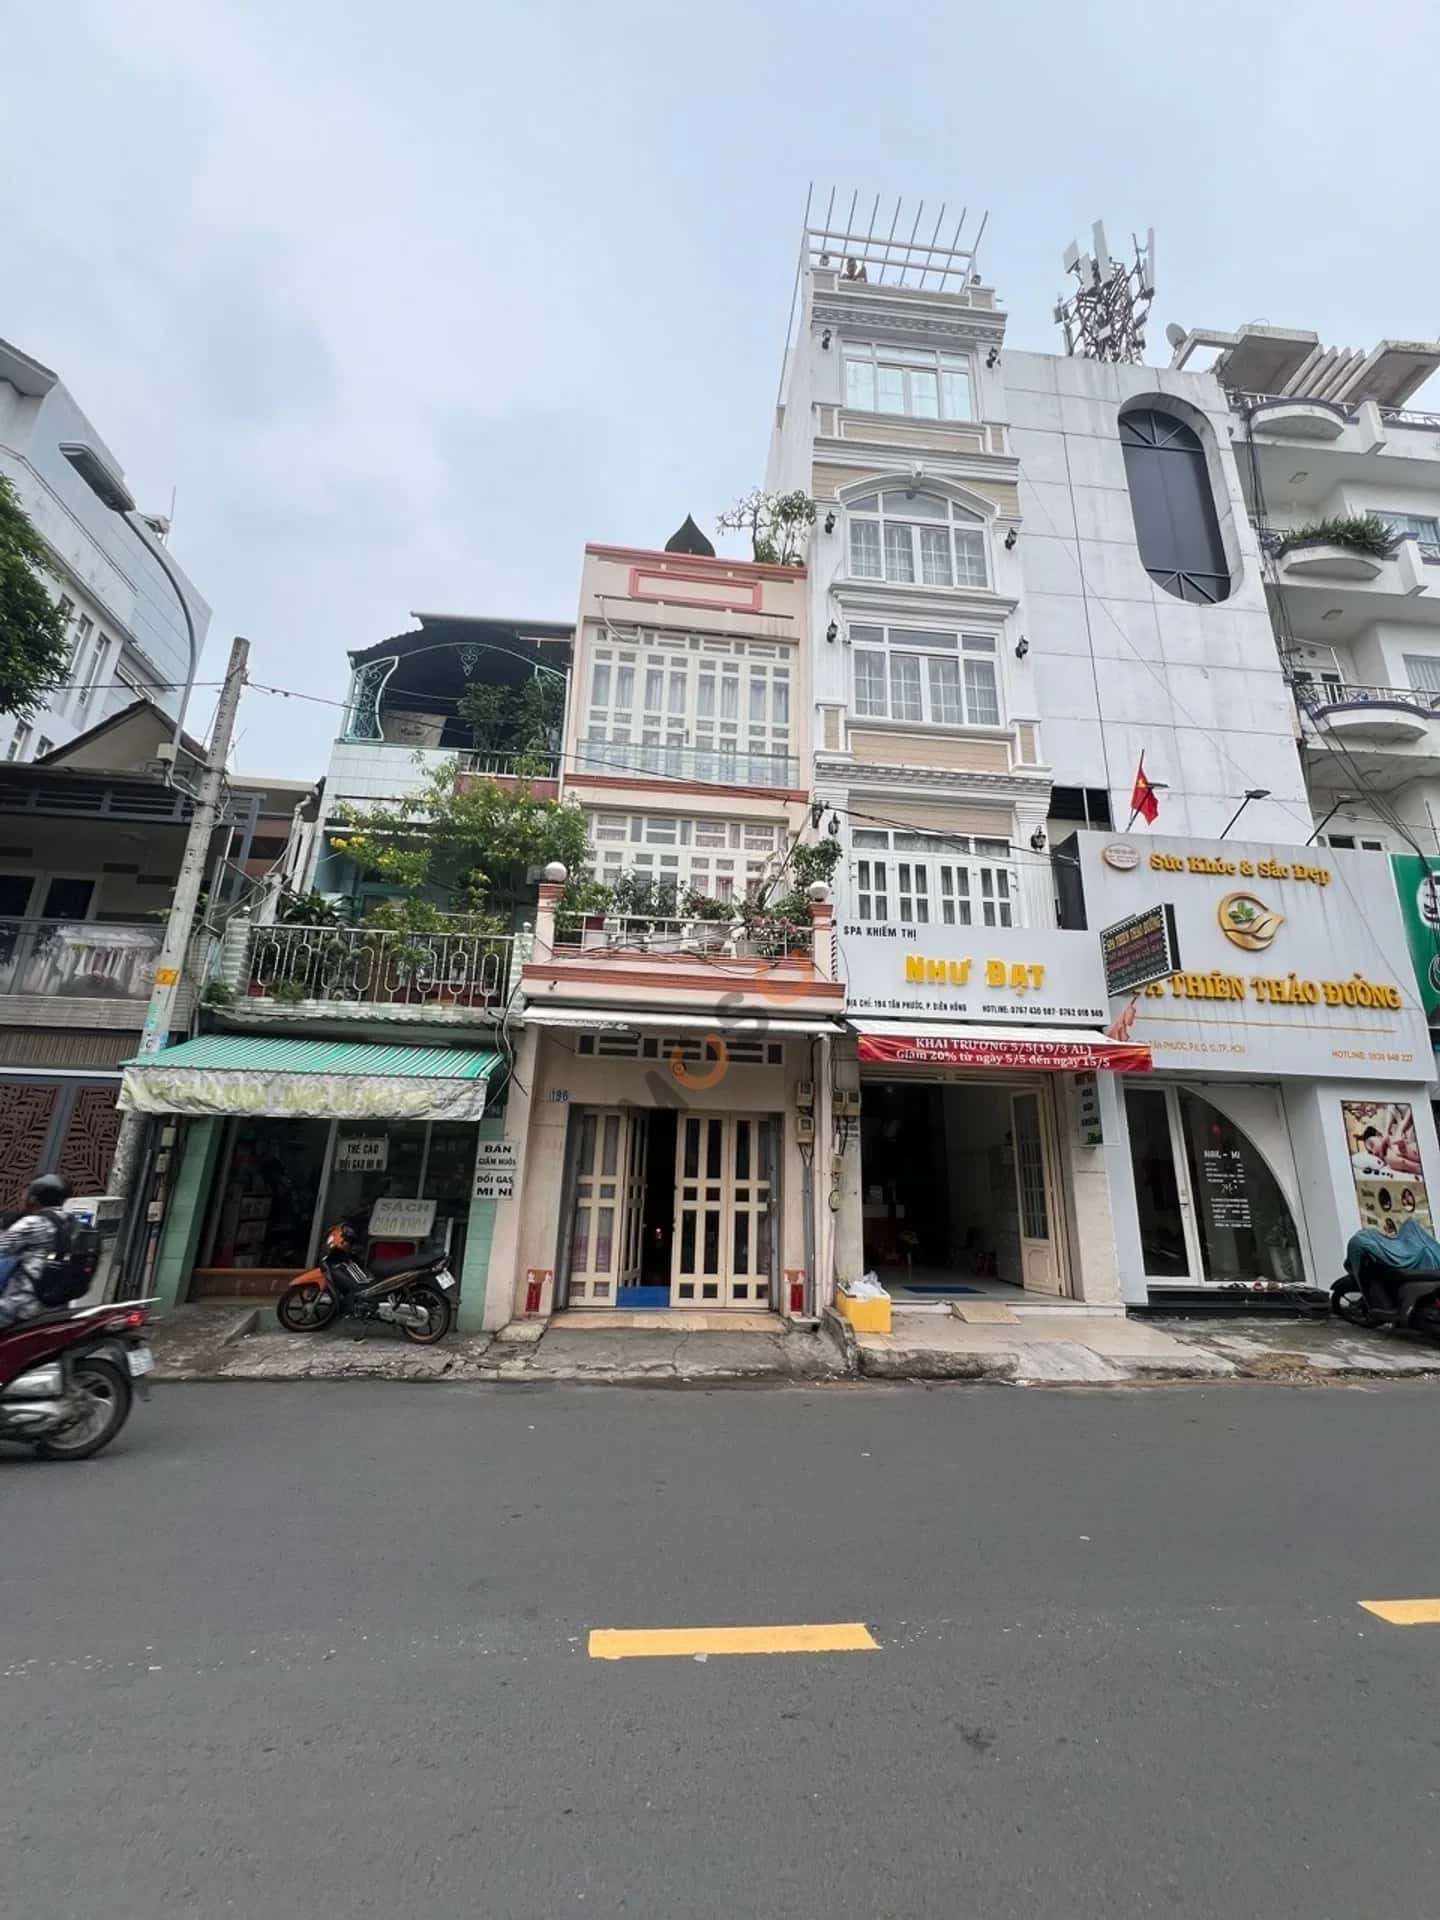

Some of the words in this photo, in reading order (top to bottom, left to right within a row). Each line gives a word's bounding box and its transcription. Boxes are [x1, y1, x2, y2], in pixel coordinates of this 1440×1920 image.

[1240, 861, 1254, 878] &
[1292, 863, 1331, 887] Đẹp
[843, 925, 862, 937] SPA
[901, 928, 917, 941] THỊ
[904, 955, 973, 986] NHƯ
[985, 958, 1046, 996] ĐẠT
[1168, 970, 1245, 1001] THIÊN
[1250, 972, 1321, 1006] THẢO
[915, 1037, 948, 1049] KHAI
[930, 1050, 958, 1062] 20%
[1005, 1053, 1026, 1066] 5/5
[1083, 1056, 1111, 1069] 15/5
[476, 1187, 494, 1196] MI
